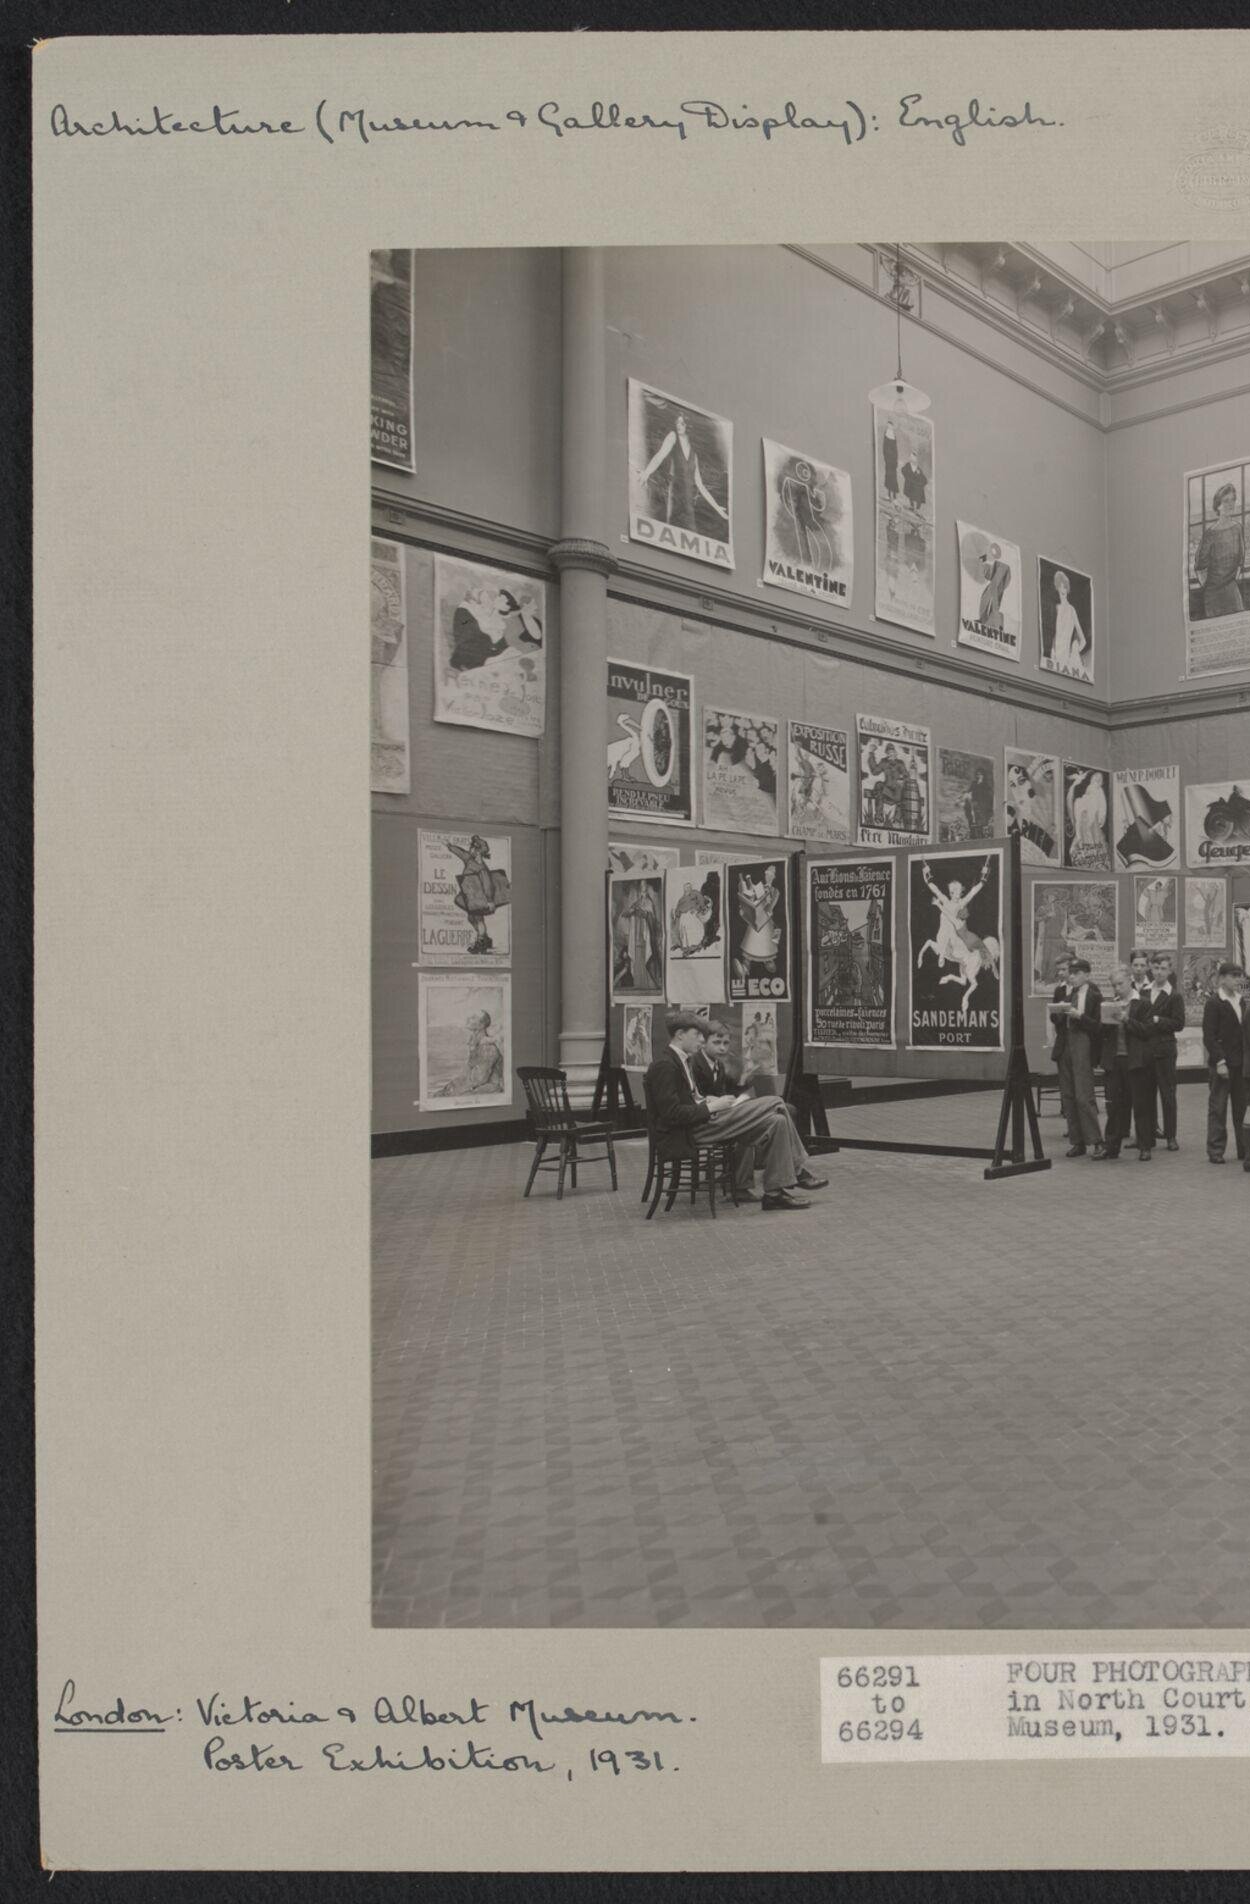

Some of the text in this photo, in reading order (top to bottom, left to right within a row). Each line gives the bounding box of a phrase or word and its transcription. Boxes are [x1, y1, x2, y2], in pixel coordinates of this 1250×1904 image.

[50, 103, 305, 137] Architecture
[316, 100, 500, 143] (Museum
[538, 102, 685, 138] Gallery
[899, 94, 1065, 146] English.
[372, 415, 409, 437] KING
[370, 429, 409, 451] WDER
[637, 517, 731, 563] DAMIA
[769, 559, 847, 598] VALENTINE
[962, 617, 1017, 647] VALENTINE
[610, 671, 690, 702] nvulner
[793, 724, 847, 744] EXPOSITION
[810, 740, 847, 768] RUSSE
[434, 868, 447, 880] LE
[423, 881, 457, 895] DESSIN
[748, 976, 786, 997] ECO
[912, 1009, 1000, 1029] SANDEMAN'S
[939, 1031, 973, 1044] PORT
[837, 1665, 920, 1688] 66291
[1007, 1660, 1077, 1684] FOUR
[871, 1694, 905, 1714] to
[1007, 1691, 1041, 1712] in
[1058, 1689, 1145, 1711] North
[196, 1693, 328, 1726] Victoria
[373, 1697, 489, 1726] Albert
[509, 1699, 697, 1739] Museum.
[1007, 1713, 1225, 1742] Museum, 1931.
[838, 1719, 924, 1743] 66294
[202, 1736, 303, 1772] Poster
[589, 1748, 680, 1781] 1931.
